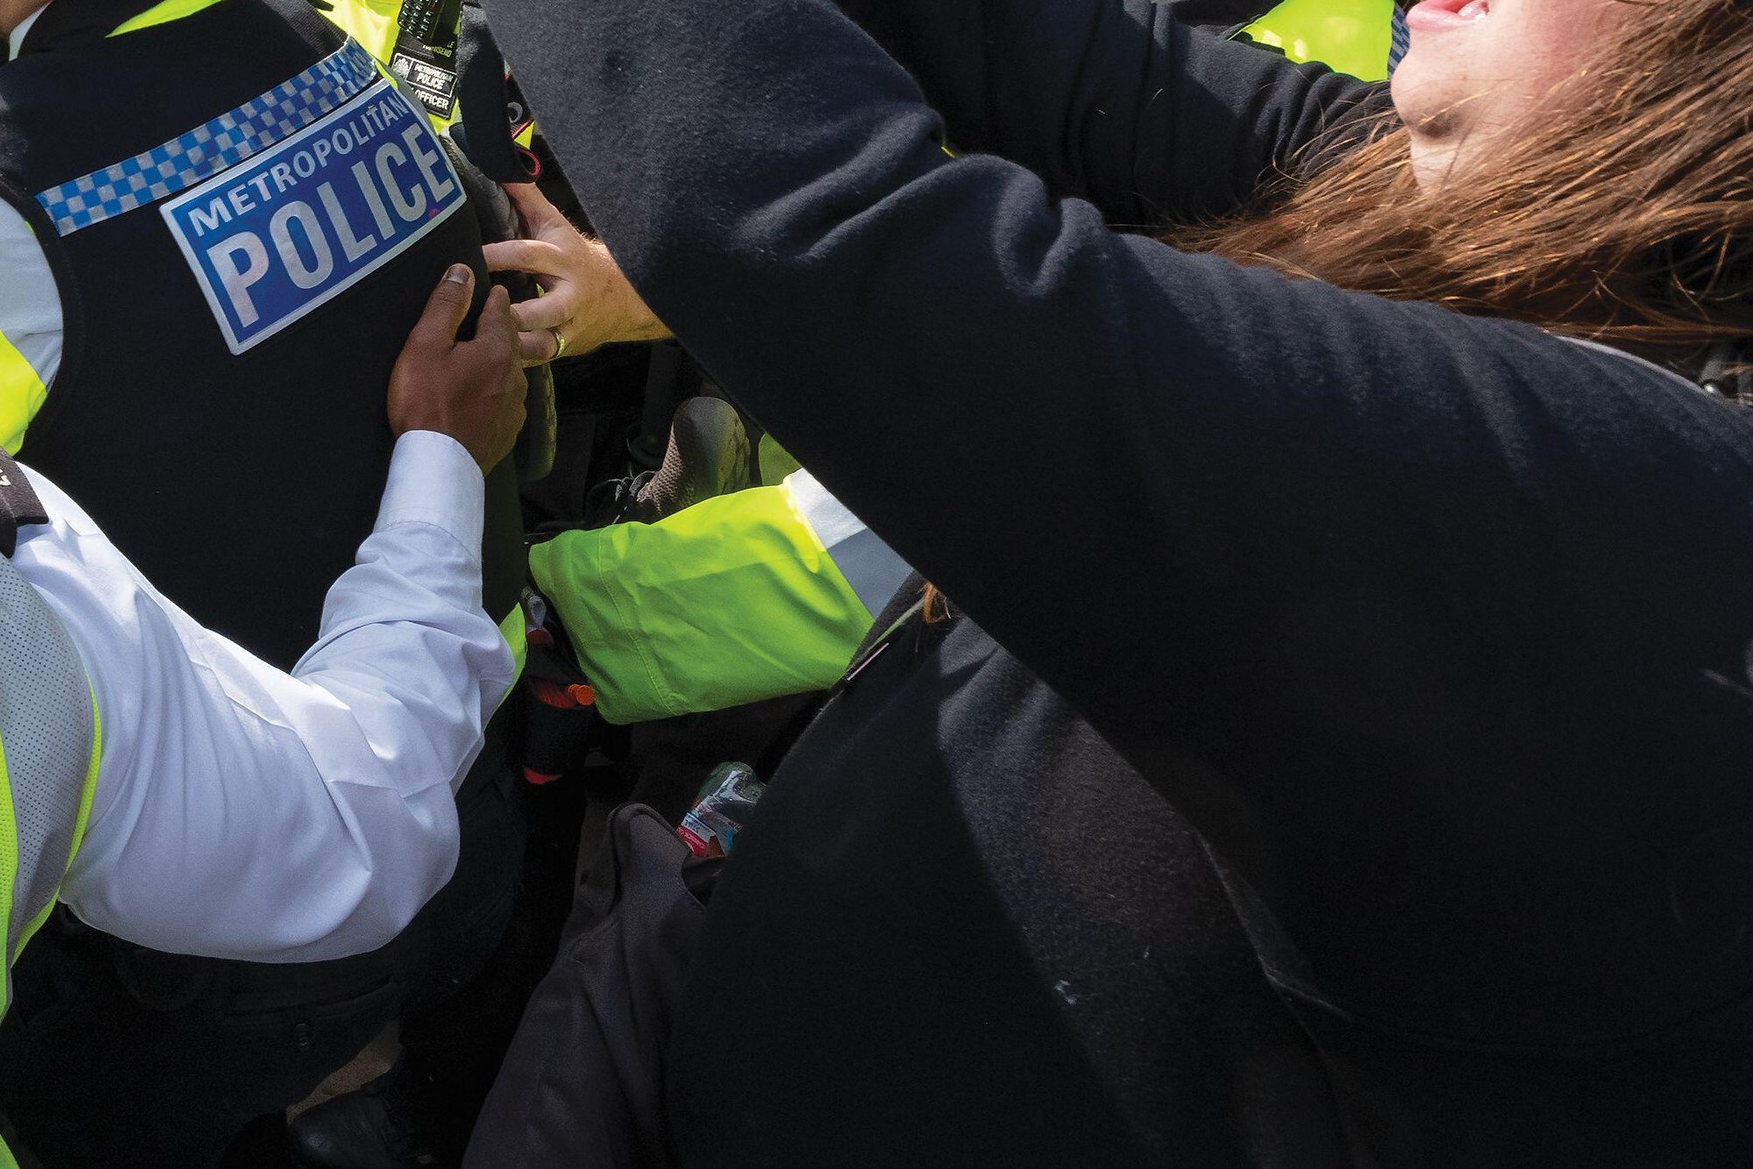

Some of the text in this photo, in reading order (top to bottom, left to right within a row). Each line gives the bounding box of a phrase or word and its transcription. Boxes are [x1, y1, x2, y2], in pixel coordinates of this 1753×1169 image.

[414, 63, 453, 82] METROPOLITAN
[416, 72, 446, 90] POLICE
[188, 91, 409, 237] METROPOLITAN
[206, 122, 455, 328] POLICE
